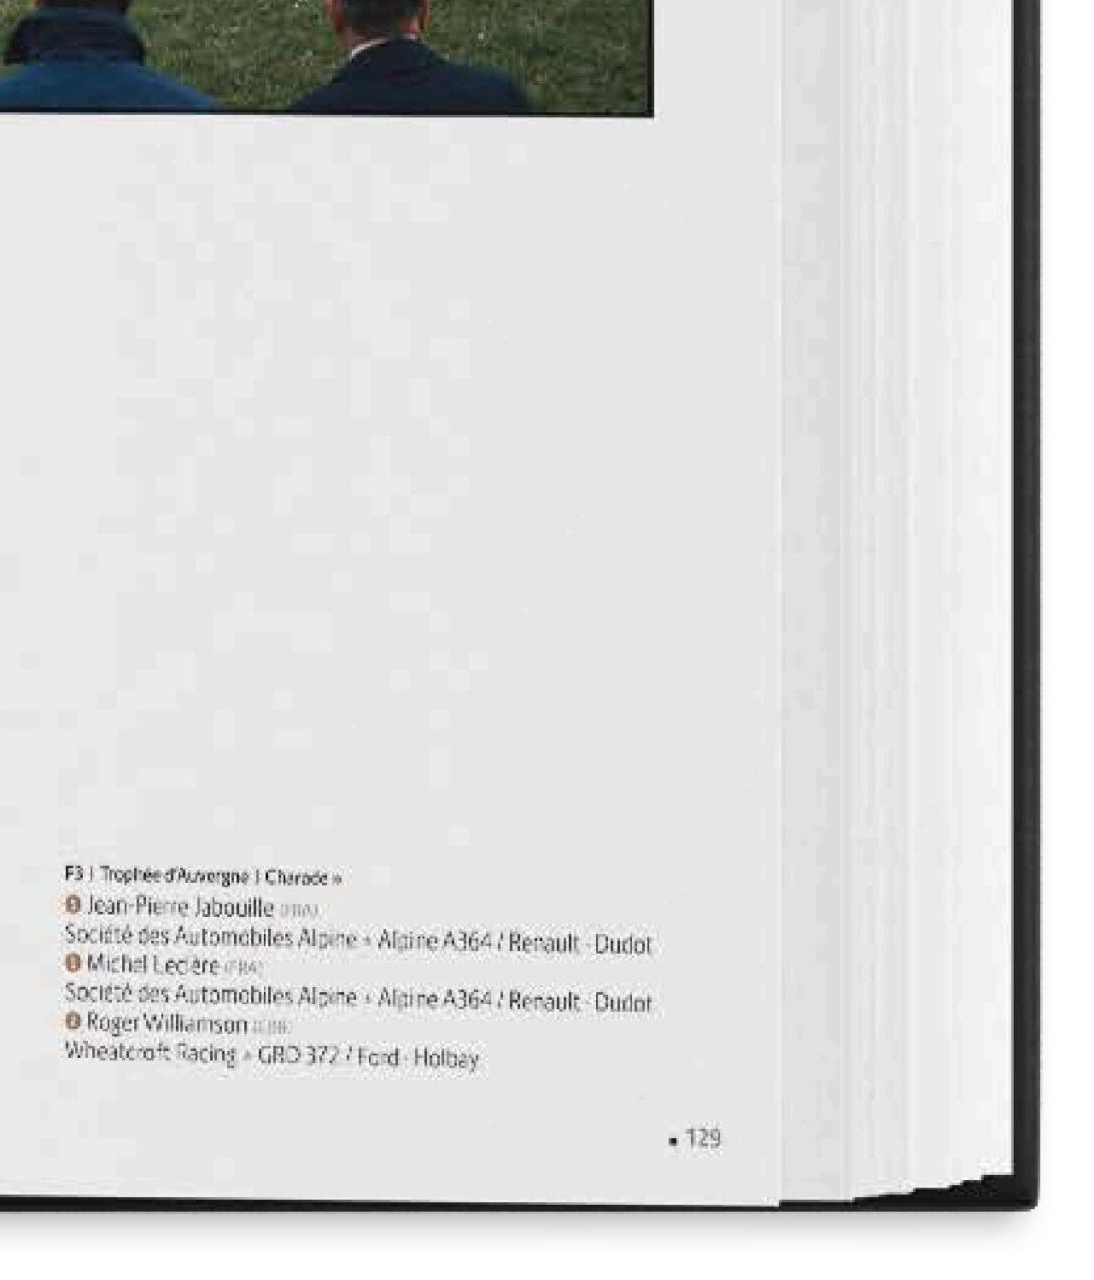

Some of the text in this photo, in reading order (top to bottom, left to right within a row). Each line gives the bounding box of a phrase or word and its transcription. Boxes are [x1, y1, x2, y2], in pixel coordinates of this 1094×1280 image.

[65, 865, 84, 881] F3
[264, 869, 329, 886] Charade
[87, 894, 189, 915] Jean-Pierre
[195, 897, 274, 917] Jabouille
[65, 923, 133, 944] Société
[138, 925, 169, 944] des
[174, 925, 293, 947] Automobiles
[298, 928, 357, 949] Alpine
[378, 929, 438, 953] Alpine
[443, 931, 492, 952] A364
[509, 932, 580, 953] Renault
[595, 933, 653, 955] Dudot
[87, 953, 147, 973] Michel
[65, 982, 133, 1003] Société
[138, 984, 169, 1003] des
[174, 984, 293, 1005] Automobiles
[298, 986, 357, 1008] Alpine
[378, 987, 438, 1012] Alpine
[443, 989, 492, 1010] A364
[509, 991, 580, 1011] Renault
[595, 991, 653, 1013] Dudot
[87, 1011, 138, 1037] Roger
[143, 1013, 248, 1035] Williamson
[65, 1040, 171, 1062] Wheatcroft
[176, 1043, 237, 1069] Racing
[358, 1047, 399, 1066] Ford
[414, 1048, 480, 1072] Holbay
[685, 1128, 721, 1148] 129
